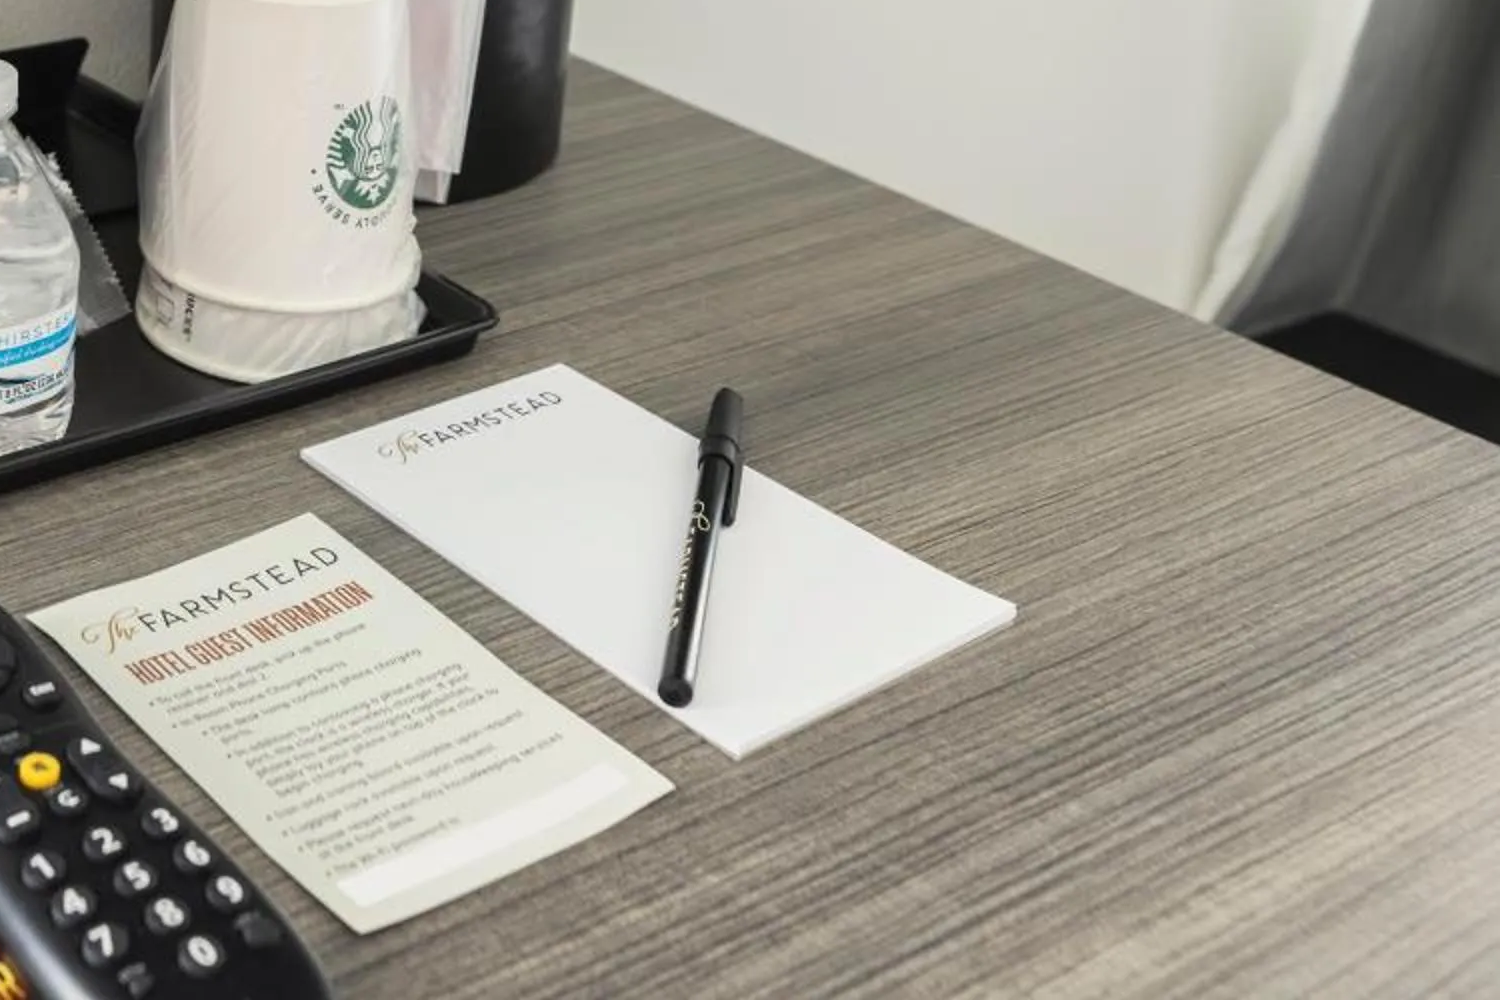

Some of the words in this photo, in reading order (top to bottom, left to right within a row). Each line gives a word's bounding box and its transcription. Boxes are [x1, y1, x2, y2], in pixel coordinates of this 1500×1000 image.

[311, 183, 351, 226] SERVE
[417, 391, 562, 447] FARMSTEAD
[138, 547, 337, 630] FARMSTEAD
[125, 650, 195, 684] HOTEL
[184, 628, 252, 664] GUEST
[243, 582, 371, 641] INFORMATION
[29, 853, 56, 879] 1
[91, 826, 123, 855] 2
[151, 807, 180, 833] 3
[63, 887, 88, 916] 4
[122, 861, 151, 891] 5
[183, 839, 212, 867] 6
[87, 923, 114, 958] 7
[153, 897, 185, 928] 8
[216, 875, 244, 904] 9
[187, 935, 219, 967] 0
